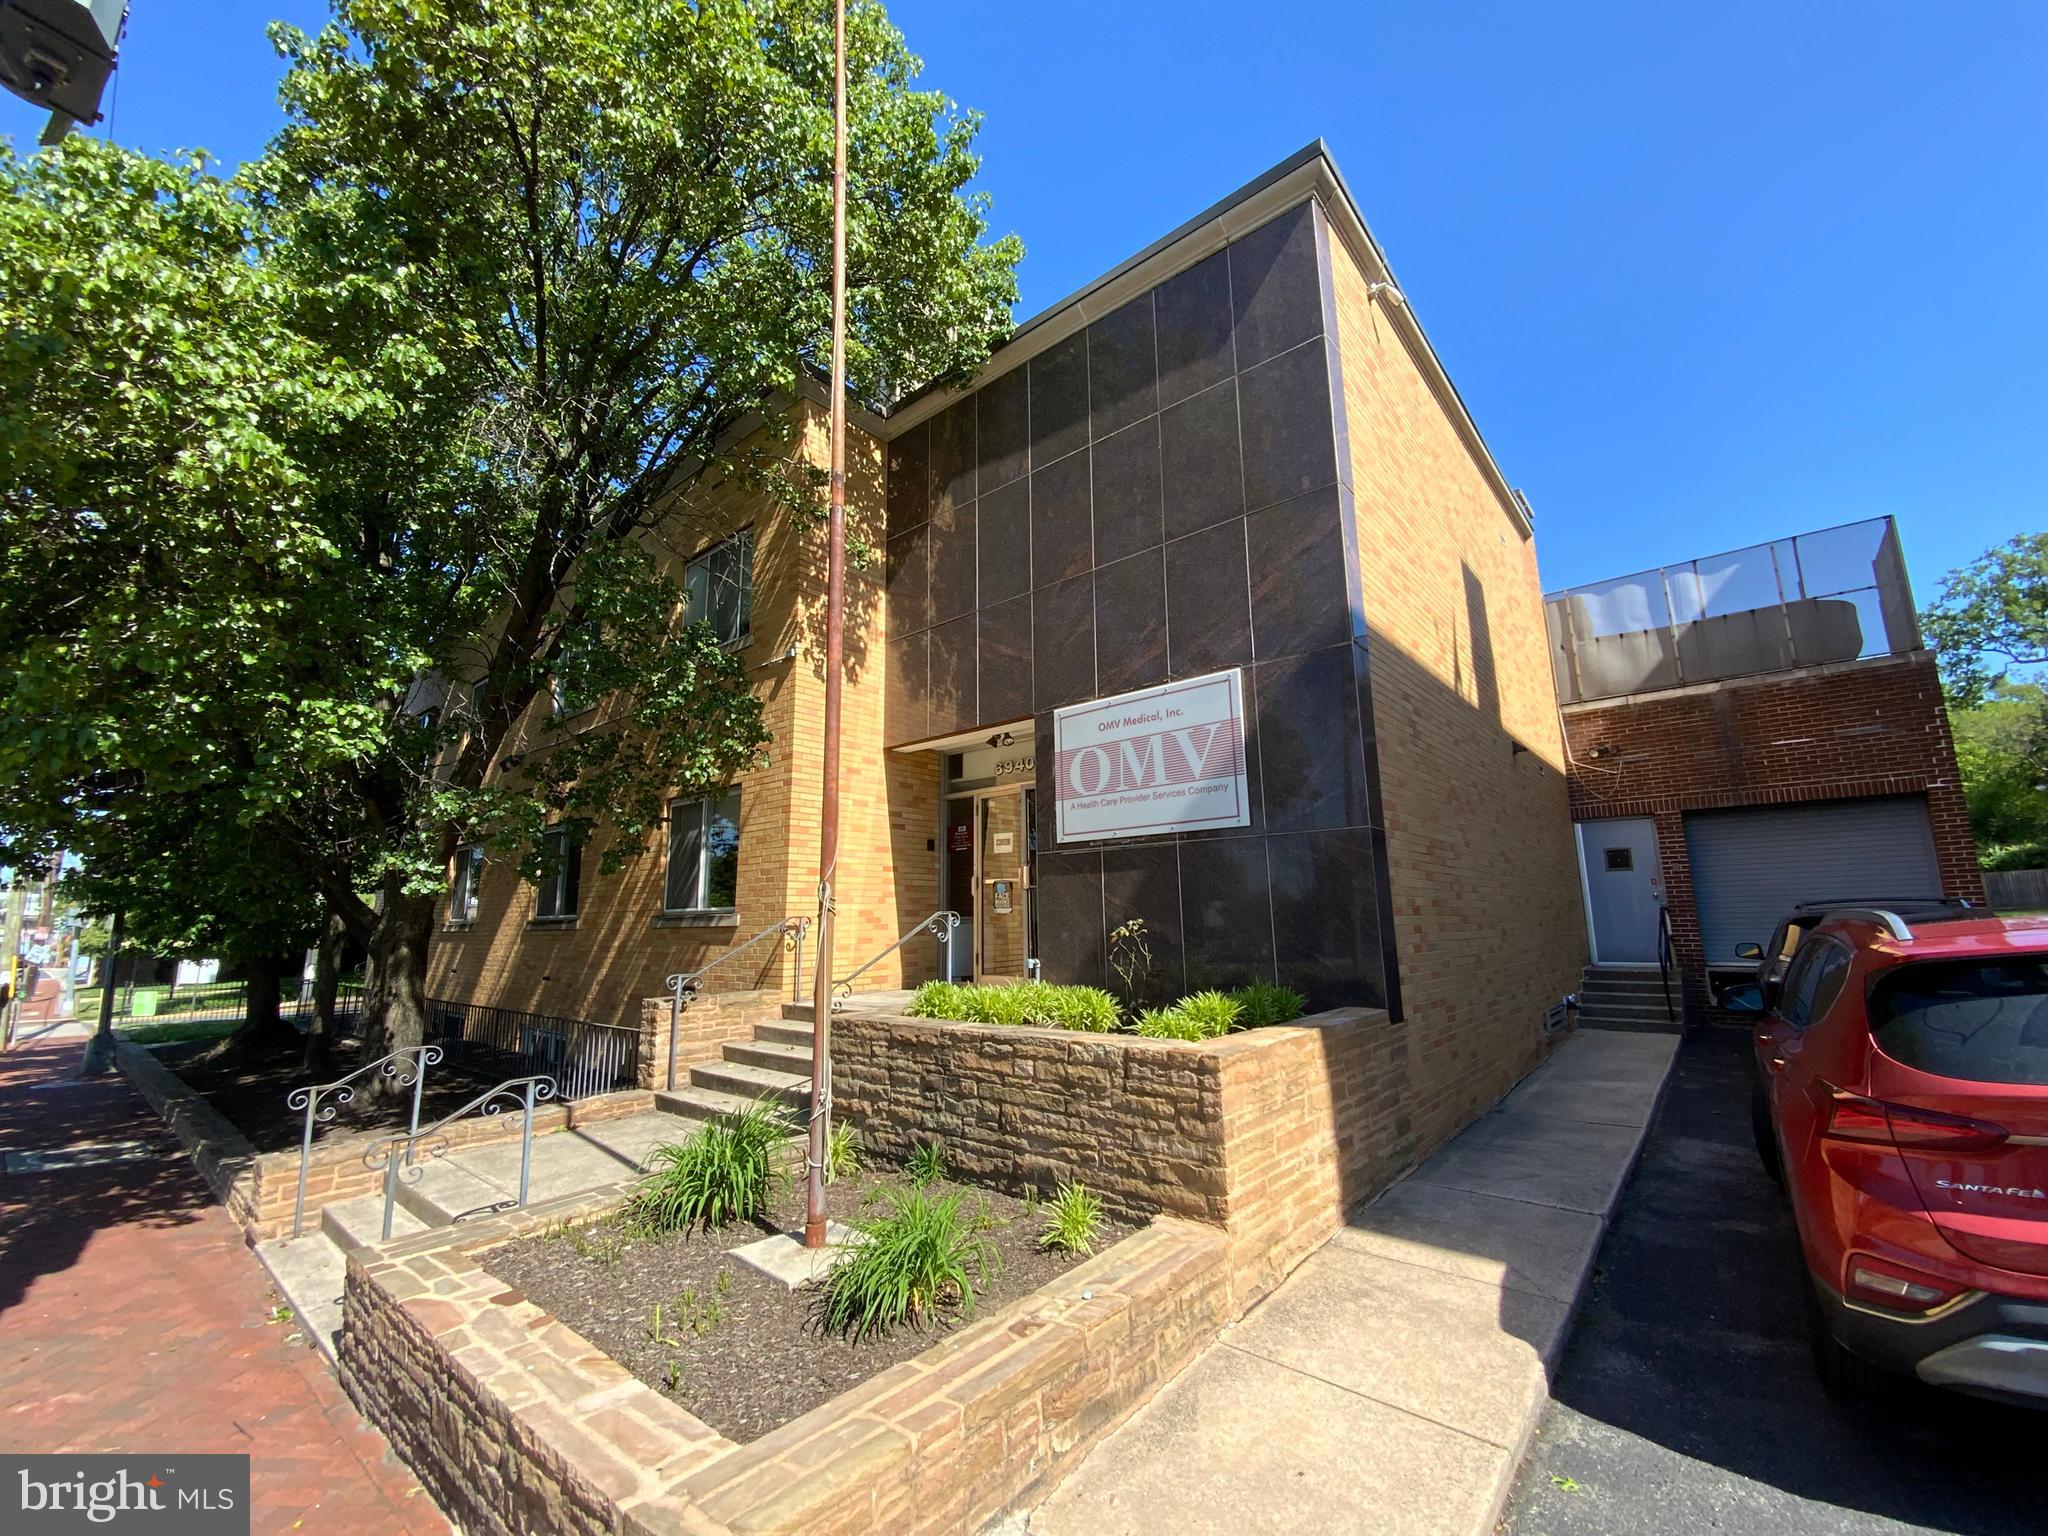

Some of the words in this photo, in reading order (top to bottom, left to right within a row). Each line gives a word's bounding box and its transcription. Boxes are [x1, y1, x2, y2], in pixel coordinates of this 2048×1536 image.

[1098, 720, 1121, 732] OMV
[1123, 711, 1163, 728] Medical,
[1166, 708, 1184, 719] Inc.
[995, 757, 1036, 776] 6940
[1070, 722, 1225, 796] OMV
[1070, 802, 1077, 811] A
[1077, 799, 1099, 810] Health
[1100, 796, 1118, 807] Care
[1120, 793, 1150, 805] Provider
[1152, 789, 1186, 801] Services
[1188, 783, 1229, 797] Company
[1935, 1180, 2004, 1195] SANTA
